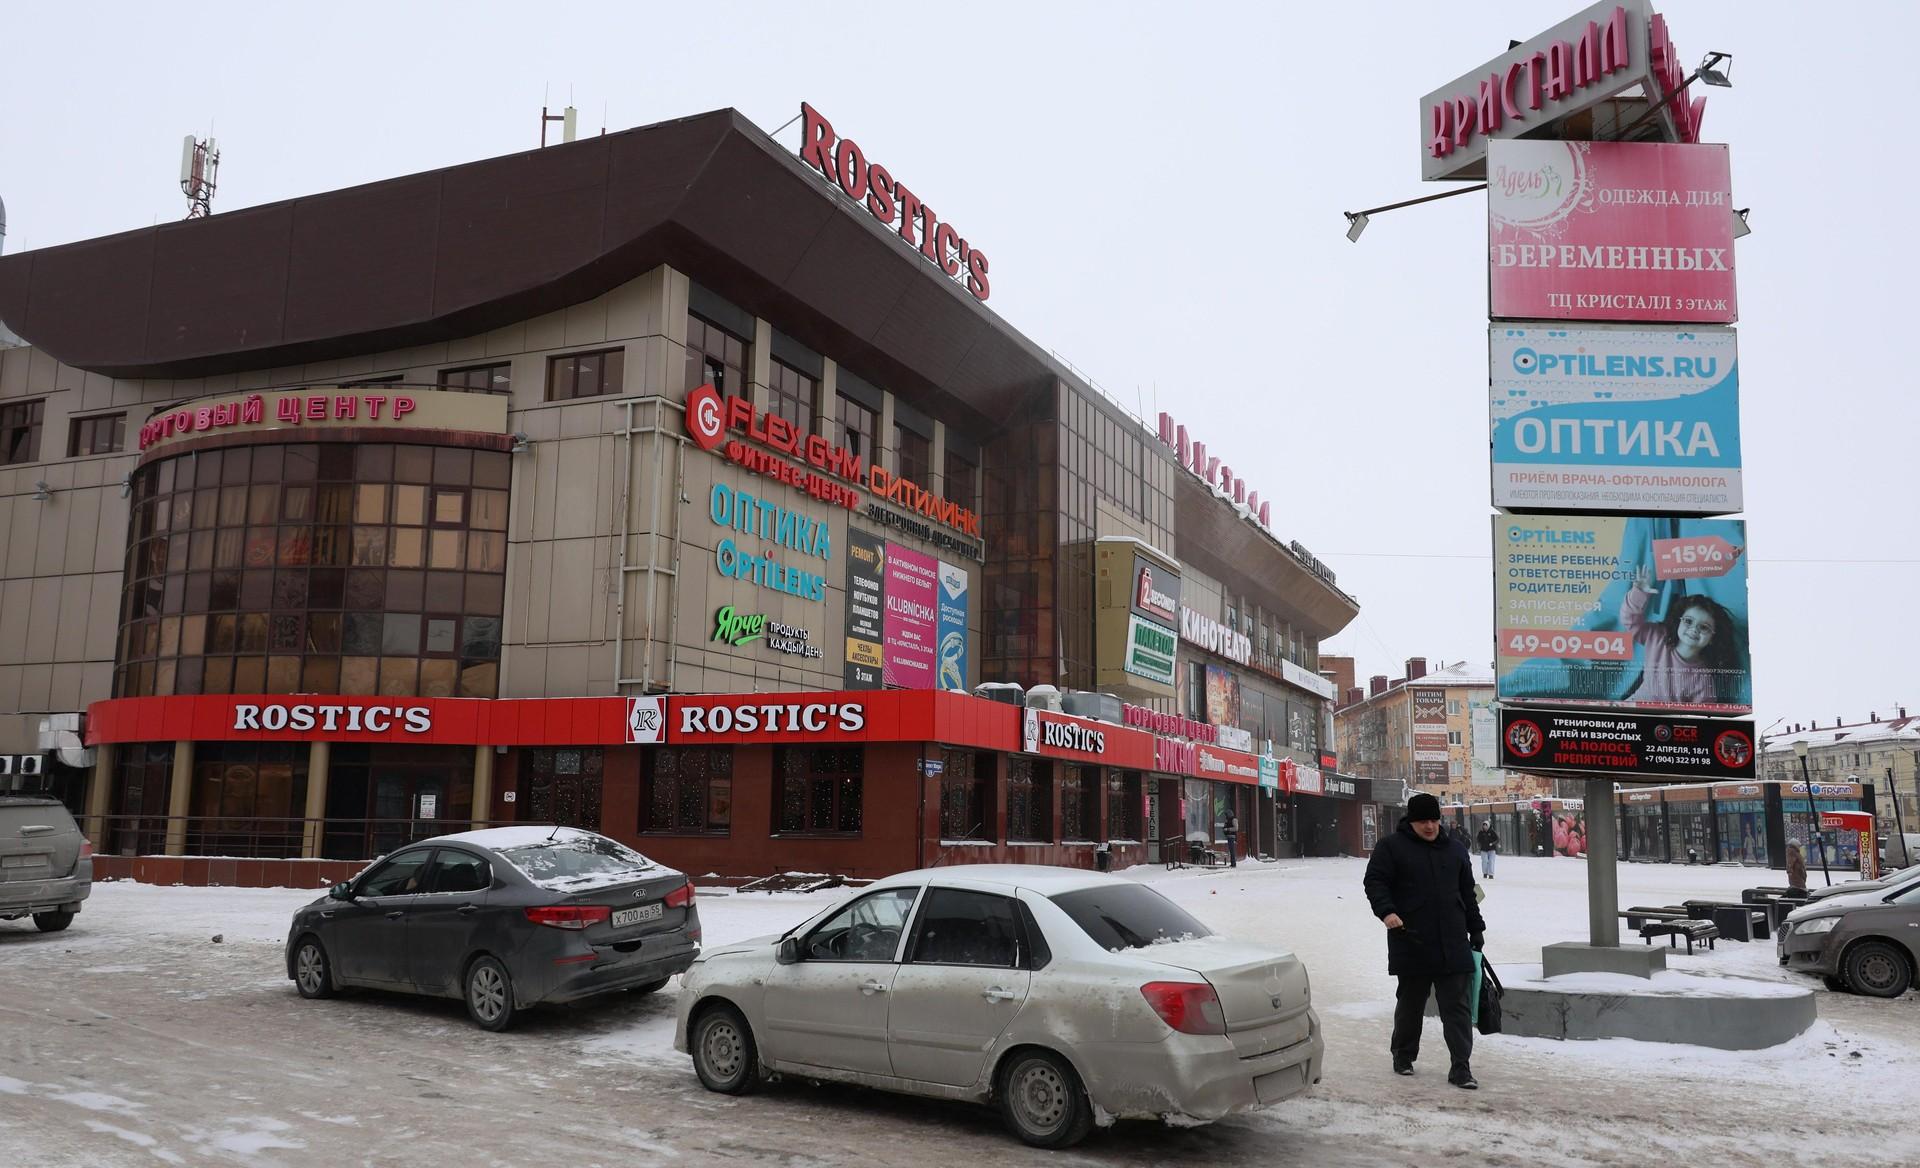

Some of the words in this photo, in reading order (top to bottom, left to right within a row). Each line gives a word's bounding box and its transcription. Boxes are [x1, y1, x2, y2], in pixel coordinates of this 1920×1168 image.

[1429, 5, 1629, 158] КРИСТАЛЛ
[1496, 165, 1542, 197] Адель
[800, 101, 990, 301] ROSTIC'S
[1599, 189, 1680, 206] ОДЕЖДА
[1685, 191, 1724, 207] ДЛЯ
[1498, 242, 1728, 271] БЕРЕМЕННЫХ
[1547, 293, 1572, 309] ТЦ
[1576, 294, 1671, 310] КРИСТАЛЛ
[1675, 299, 1682, 309] 3
[1686, 298, 1727, 311] ЭТАЖ
[276, 395, 416, 424] ЦЕНТР
[727, 394, 803, 458] FLEX
[805, 433, 863, 485] GYM
[1514, 417, 1721, 457] ОПТИКА
[723, 440, 860, 511] ФИТНЕС-ЦЕНТР
[1509, 470, 1558, 484] ПРИЁМ
[1562, 474, 1728, 487] ВРАЧА-ОФТАЛЬМОЛОГА
[870, 464, 980, 540] СИТИЛИНК
[710, 482, 831, 561] ОПТИКА
[851, 545, 875, 562] РЕМОНТ
[1508, 553, 1558, 565] ЗРЕНИЕ
[1561, 554, 1620, 566] РЕБЕНКА
[1662, 544, 1722, 563] -15%
[893, 558, 919, 574] АКТИВНОМ
[1508, 567, 1637, 581] ОТВЕТСТВЕННОСТЬ
[853, 575, 879, 591] ТЕЛЕФОНОВ
[892, 570, 916, 584] НИЖНЕГО
[1509, 581, 1592, 594] РОДИТЕЛЕЙ!
[853, 590, 878, 605] НОУТБУКОВ
[1509, 600, 1603, 611] ЗАПИСАТЬСЯ
[852, 604, 879, 619] ПЛАНШЕТОВ
[1509, 615, 1530, 625] НА
[1534, 613, 1586, 627] ПРИЁМ:
[714, 606, 767, 643] Ярче!
[770, 622, 810, 641] ПРОДУКТЫ
[1181, 604, 1252, 667] КИНОТЕАТР
[769, 637, 804, 655] КАЖДЫЙ
[804, 645, 824, 658] ДЕНЬ
[857, 642, 873, 654] ЧЕХЛЫ
[1509, 634, 1626, 656] 49-09-04
[851, 653, 879, 666] АКСЕССУАРЫ
[855, 667, 861, 681] 3
[233, 704, 432, 733] ROSTIC'S
[680, 702, 865, 734] ROSTIC'S
[1123, 702, 1186, 737] ТОРГОВЫЙ
[1185, 719, 1218, 742] ЦЕНТР
[1553, 718, 1615, 728] ТРЕНИРОВКИ
[1616, 721, 1637, 731] ДЛЯ
[1044, 720, 1105, 754] ROSTIC'S
[1549, 729, 1578, 739] ДЕТЕЙ
[1580, 731, 1588, 739] И
[1590, 732, 1642, 742] ВЗРОСЛЫХ
[1673, 727, 1697, 738] OCR
[1560, 741, 1578, 751] НА
[1580, 742, 1632, 753] ПОЛОСЕ
[1656, 746, 1691, 755] АПРЕЛЯ,
[1693, 747, 1709, 755] 18/1
[1554, 752, 1638, 768] ПРЕПЯТСТВИЙ
[1655, 755, 1674, 765] (904)
[1675, 756, 1689, 764] 322
[1690, 757, 1700, 765] 91
[634, 890, 646, 898] KIA
[652, 904, 661, 915] 55
